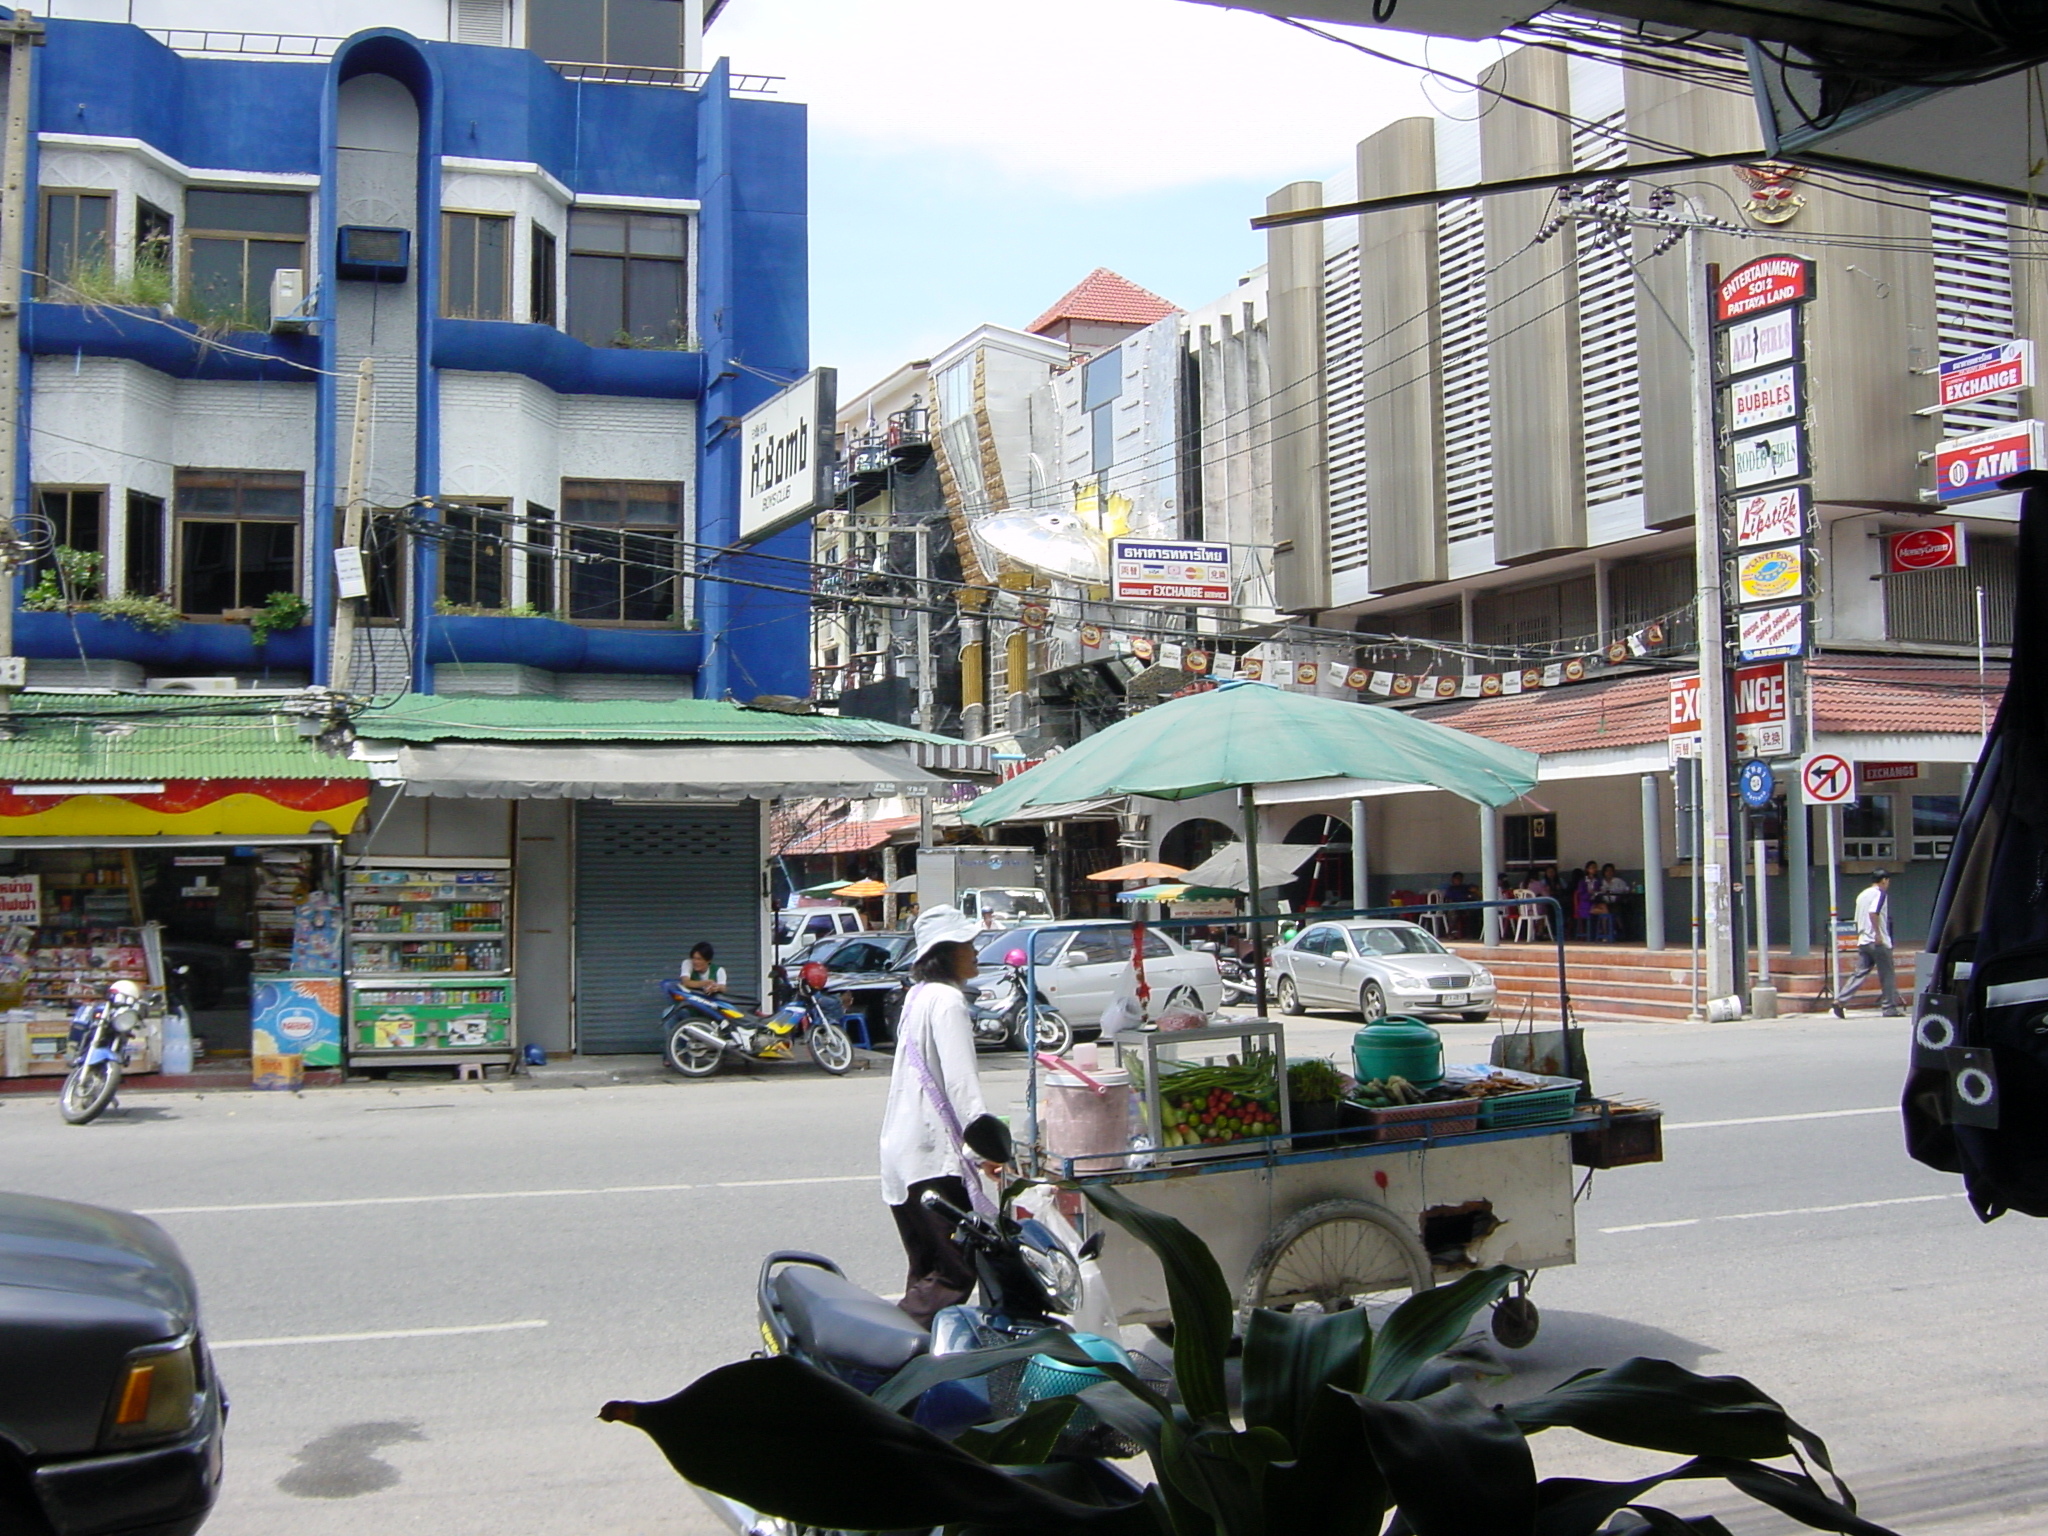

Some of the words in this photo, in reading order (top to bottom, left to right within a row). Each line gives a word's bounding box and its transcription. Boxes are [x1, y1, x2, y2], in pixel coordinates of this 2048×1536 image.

[1722, 260, 1800, 301] ENTERTAINMENT
[1727, 294, 1766, 316] PATTAYA
[1766, 285, 1795, 304] LAND
[1732, 333, 1754, 364] ALL
[1760, 321, 1791, 356] GIRLS
[1737, 384, 1791, 413] BUBBLES
[1946, 367, 2018, 402] EXCHANGE
[1736, 449, 1768, 474] RODEO
[1771, 439, 1796, 469] GIRLS
[1974, 449, 2018, 480] ATM
[1740, 493, 1798, 541] Lipstick
[1124, 547, 1223, 561] ธนาคารทหารไทย
[1745, 551, 1776, 571] PLANET
[1899, 543, 1949, 557] MoneyGram
[1152, 585, 1204, 598] EXCHANGE
[1867, 765, 1914, 780] EXCHANGE
[8, 914, 37, 923] SALE
